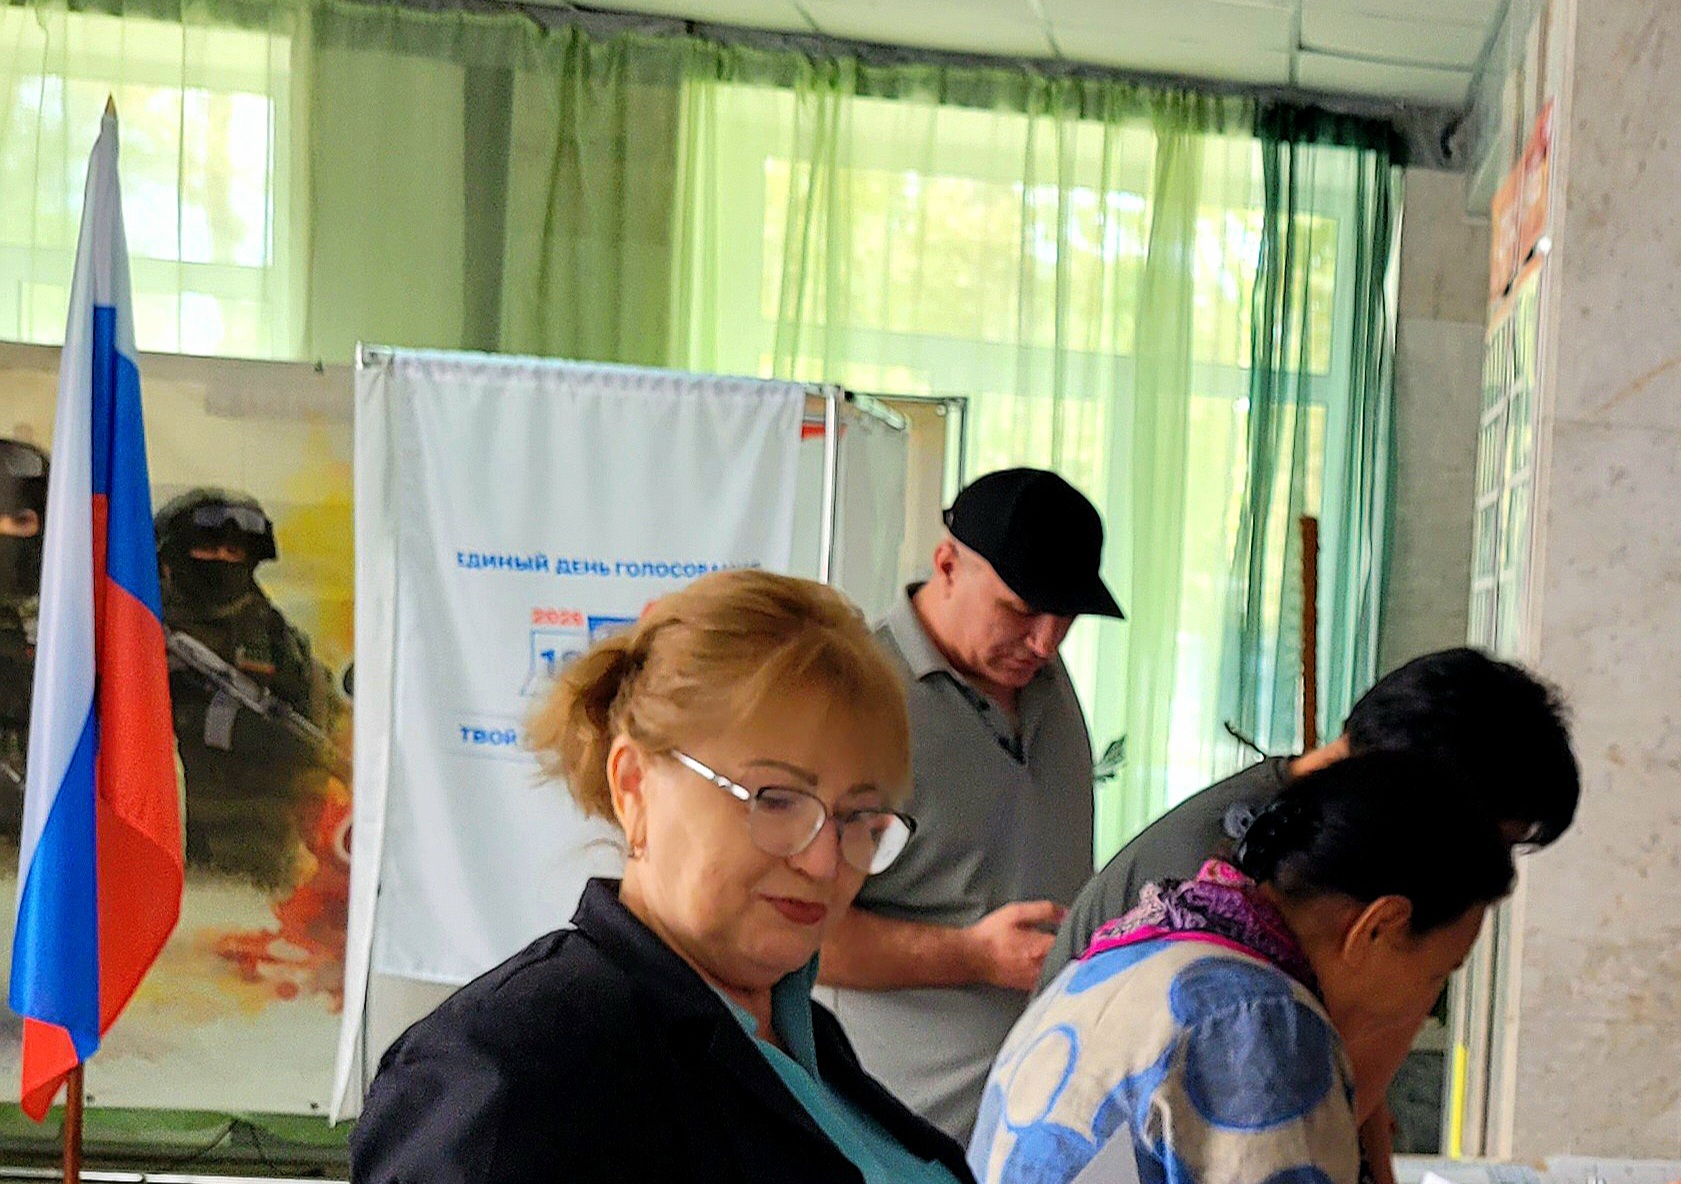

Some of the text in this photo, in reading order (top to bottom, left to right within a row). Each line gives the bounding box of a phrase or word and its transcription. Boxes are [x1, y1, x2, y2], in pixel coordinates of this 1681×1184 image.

[456, 550, 549, 574] ЕДИНЫЙ
[555, 556, 610, 577] ДЕНЬ
[460, 725, 518, 746] ТВОЙ
